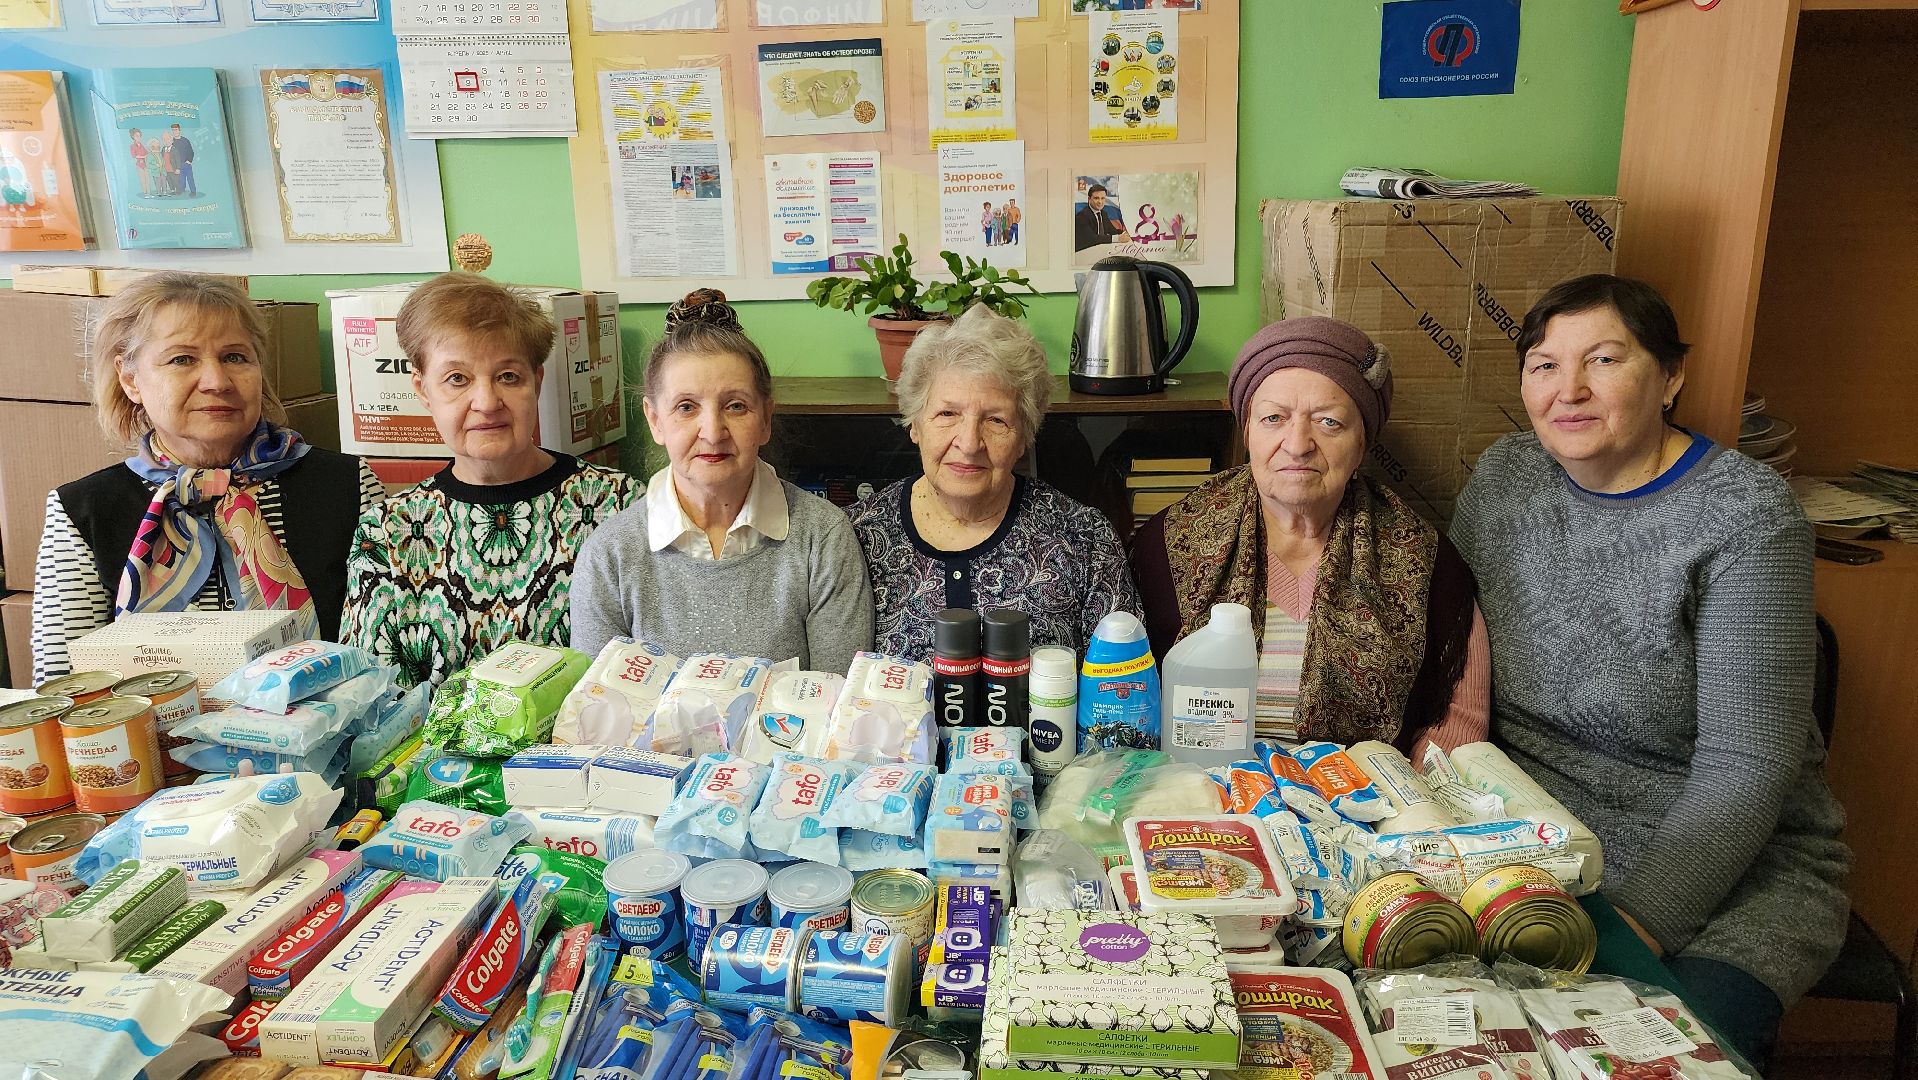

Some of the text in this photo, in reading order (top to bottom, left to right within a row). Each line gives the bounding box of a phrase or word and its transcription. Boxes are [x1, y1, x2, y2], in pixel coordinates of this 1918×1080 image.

[437, 4, 446, 12] 18
[1420, 74, 1469, 82] ПЕНСИОНЕРОВ
[944, 172, 1003, 182] Здоровое
[944, 184, 1015, 194] долголетие
[1135, 204, 1159, 240] 8
[354, 339, 371, 347] ATF
[575, 360, 589, 374] ZIC
[268, 647, 316, 666] tafo
[619, 655, 652, 682] tafo
[696, 660, 726, 679] tafo
[1093, 665, 1123, 674] ВЫГОДНАЯ
[880, 665, 908, 690] tafo
[1189, 698, 1235, 708] ПЕРЕКИСЬ
[1032, 727, 1059, 738] NIVEA
[1036, 736, 1055, 745] MEN
[973, 732, 994, 754] tafo
[707, 767, 739, 792] tafo
[873, 770, 903, 790] tafo
[1320, 765, 1348, 789] БИНТ
[791, 774, 821, 806] tafo
[1015, 804, 1026, 816] 20
[409, 816, 461, 838] tafo
[543, 836, 598, 857] tafo
[1149, 832, 1253, 850] Доширак
[223, 873, 309, 934] ACTIDENT
[617, 902, 660, 915] СВЕТАЕВО
[1380, 894, 1413, 918] ОМКК
[807, 909, 848, 930] СВЕТАЕВО
[130, 903, 210, 959] БАННОЕ
[263, 902, 341, 963] Colgate
[620, 924, 660, 935] МОЛОКО
[192, 939, 237, 949] SENSITIVE
[331, 907, 402, 972] ACTIDENT
[1082, 933, 1143, 950] pretty
[374, 919, 445, 987] ACTIDENT
[467, 921, 519, 994] Colgate
[567, 930, 589, 969] Colgate
[248, 965, 281, 976] Colgate
[625, 964, 636, 979] 5
[709, 961, 717, 972] 360
[1036, 984, 1081, 992] марлевые
[1083, 985, 1143, 993] медицинские
[1093, 978, 1147, 986] САЛФЕТКИ
[451, 988, 482, 1013] Colgate
[1237, 992, 1340, 1013] оширак
[266, 1031, 308, 1041] ACTIDENT
[1098, 1032, 1149, 1042] САЛФЕТКИ
[328, 1048, 370, 1056] ACTIDENT
[1047, 1039, 1200, 1052] марлевые медицинские СТЕРИЛЬНЫЕ
[1406, 1058, 1468, 1080] ВИШНЯ
[1411, 1055, 1453, 1068] Кисель
